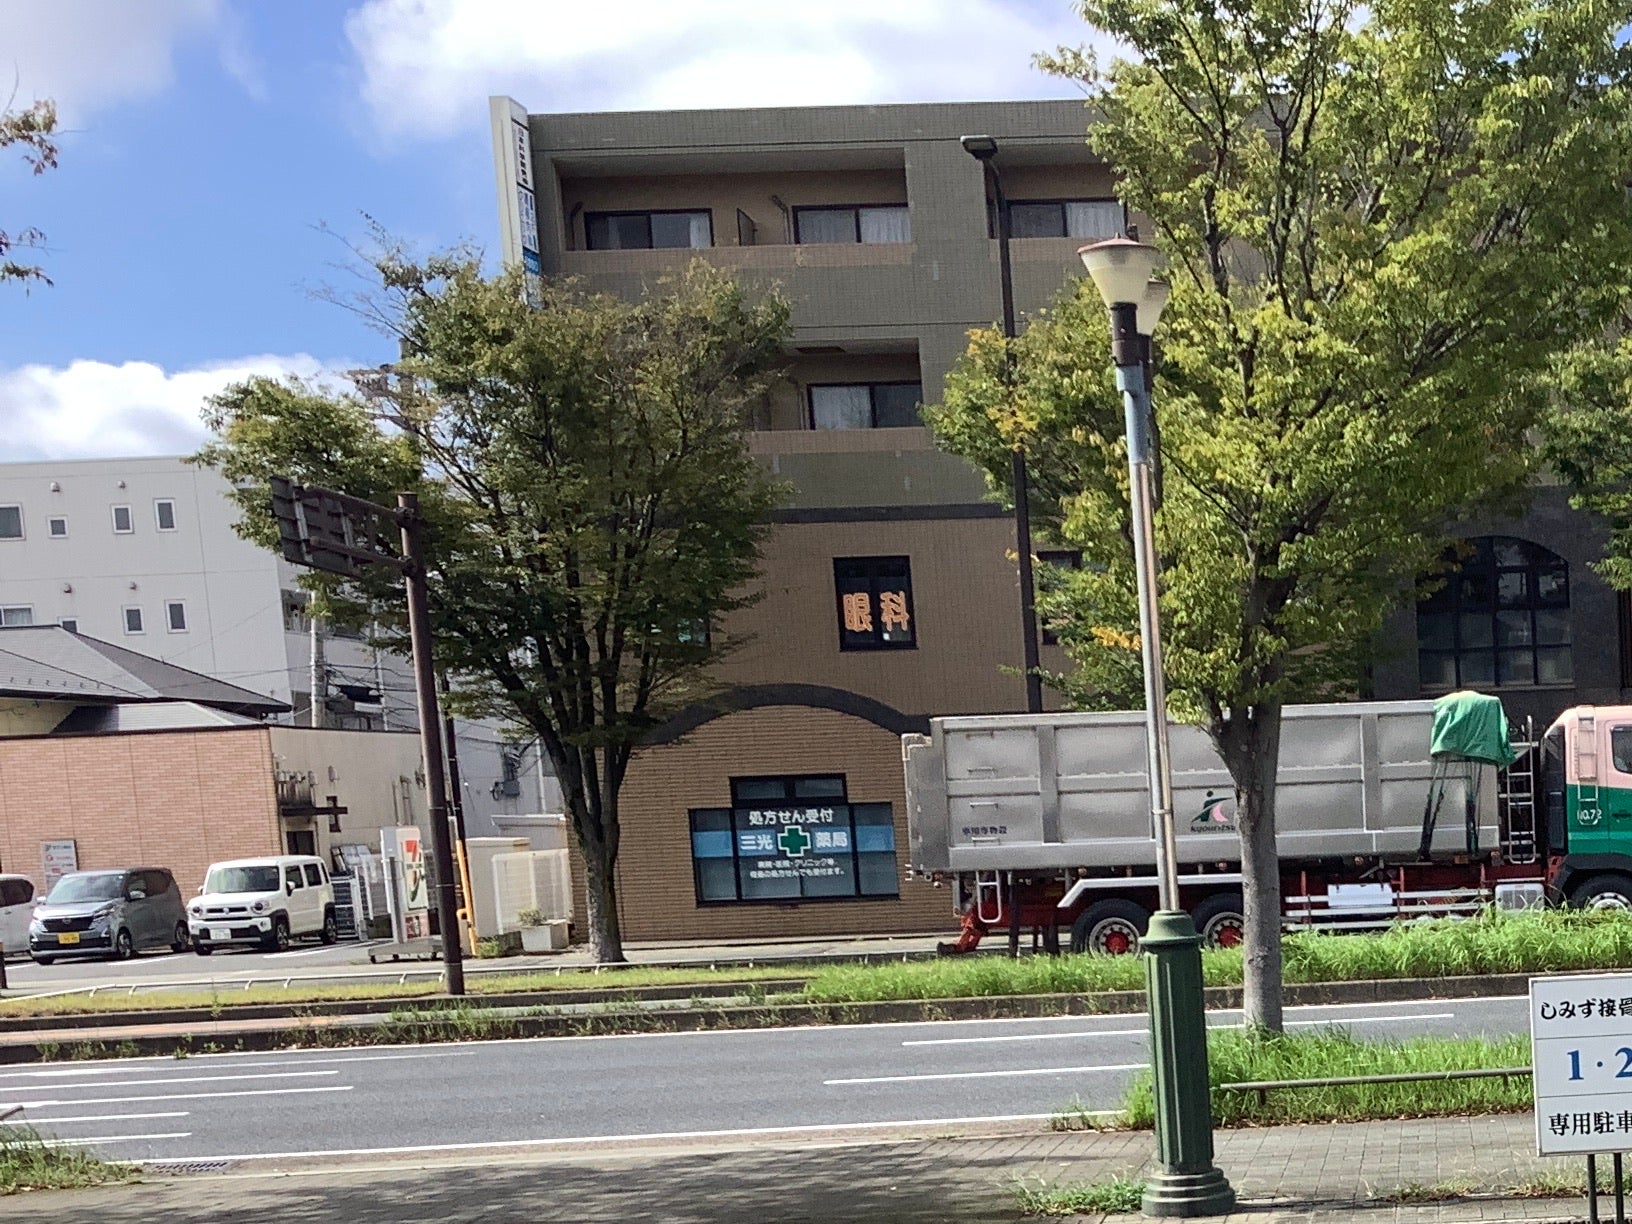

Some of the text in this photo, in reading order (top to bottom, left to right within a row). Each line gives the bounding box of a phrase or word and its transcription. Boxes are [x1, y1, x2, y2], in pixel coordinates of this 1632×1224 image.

[842, 590, 910, 633] 眼科
[748, 807, 834, 826] 処方せん受付
[740, 831, 849, 851] 三光 薬局
